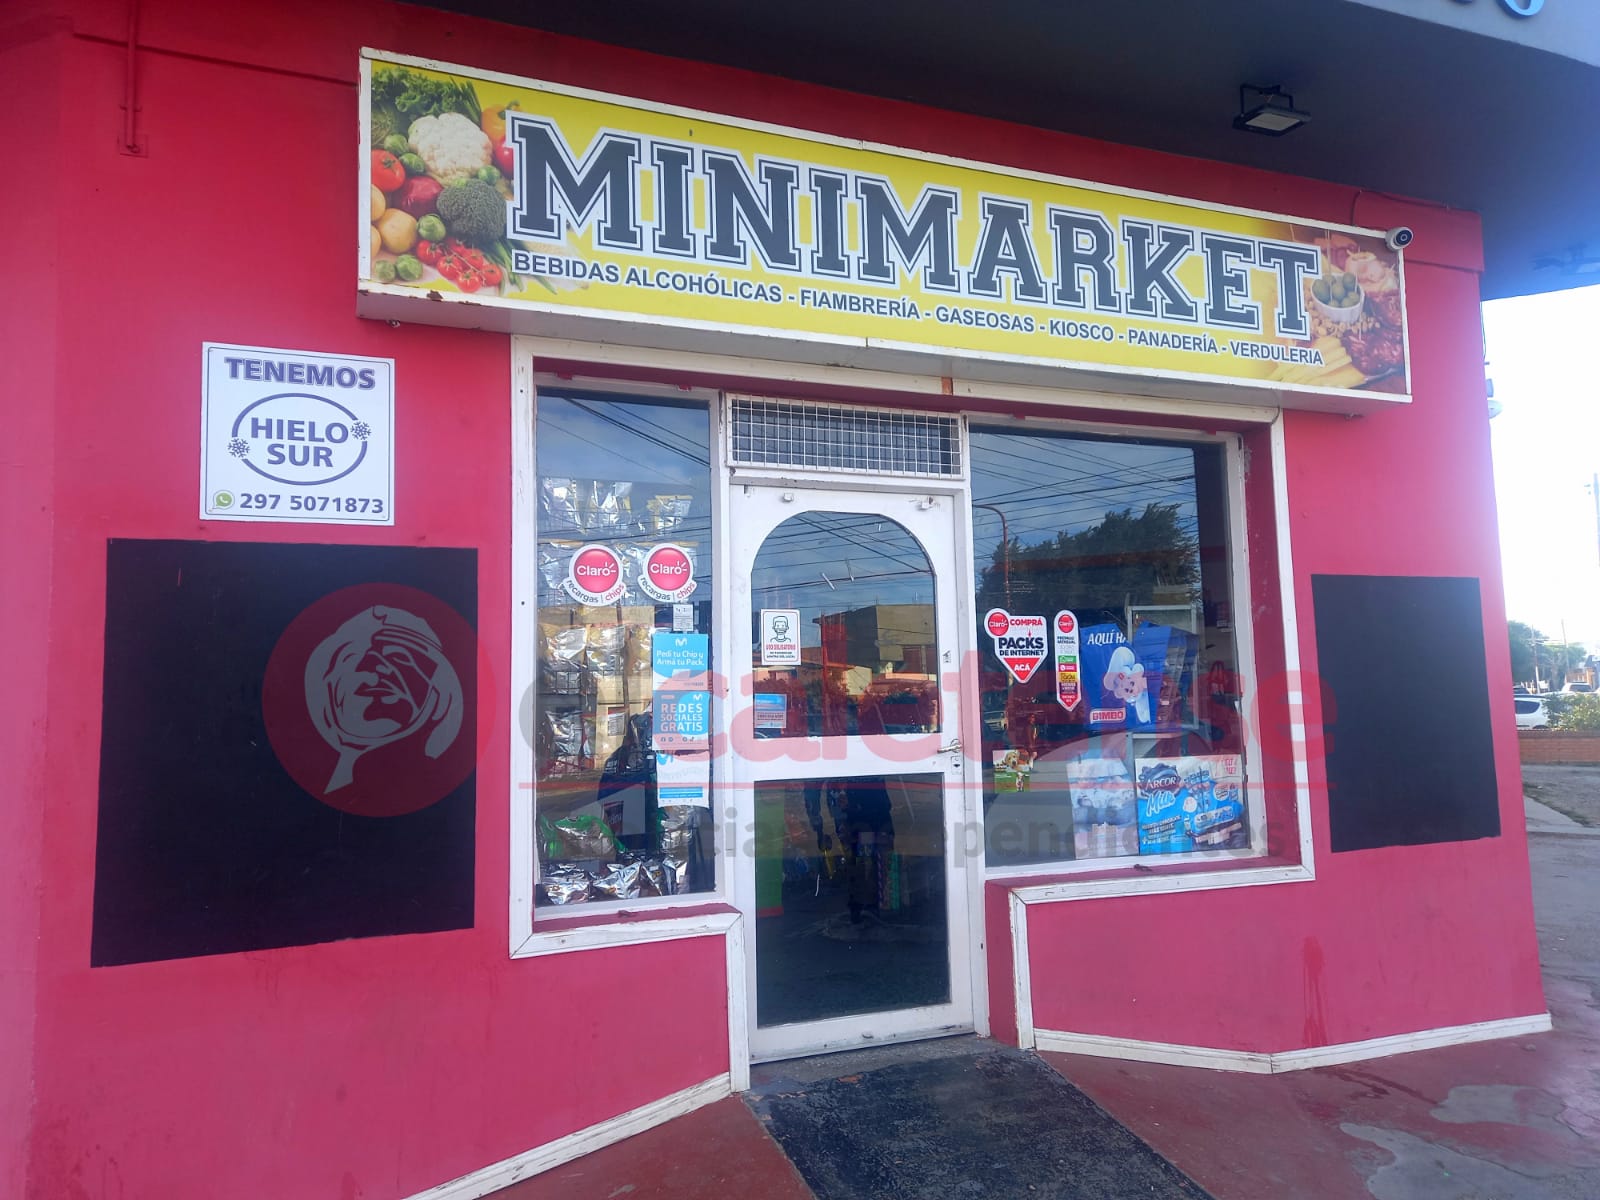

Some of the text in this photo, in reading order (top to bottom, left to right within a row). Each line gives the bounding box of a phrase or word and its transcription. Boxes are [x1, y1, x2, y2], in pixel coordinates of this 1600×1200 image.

[509, 114, 1319, 338] MINIMARKET
[514, 253, 620, 283] BEBIDAS
[625, 267, 782, 302] ALCOHÓLICAS
[800, 288, 921, 320] FIAMBRERÍA
[936, 306, 1035, 333] GASEOSAS
[1049, 320, 1114, 342] KIOSCO
[1128, 329, 1219, 354] PANADERÍA
[1230, 343, 1324, 365] VERDULERIA
[224, 357, 376, 390] TENEMOS
[250, 417, 349, 444] HIELO
[267, 443, 334, 467] SUR
[239, 493, 384, 514] 297 5071873
[576, 563, 614, 577] Claro
[650, 561, 686, 576] Claro
[566, 579, 625, 604] recargas chips
[640, 577, 696, 601] recargas chips
[1009, 617, 1043, 626] COMPRÁ
[999, 637, 1045, 650] PACKS
[1088, 630, 1114, 646] AQUÍ
[682, 650, 697, 659] Chip
[1014, 662, 1031, 671] ACÁ
[661, 703, 703, 713] REDES
[661, 713, 703, 722] SOCIALES
[1092, 711, 1124, 721] BIMBO
[661, 722, 703, 732] GRATIS
[1145, 776, 1177, 790] ARCOR
